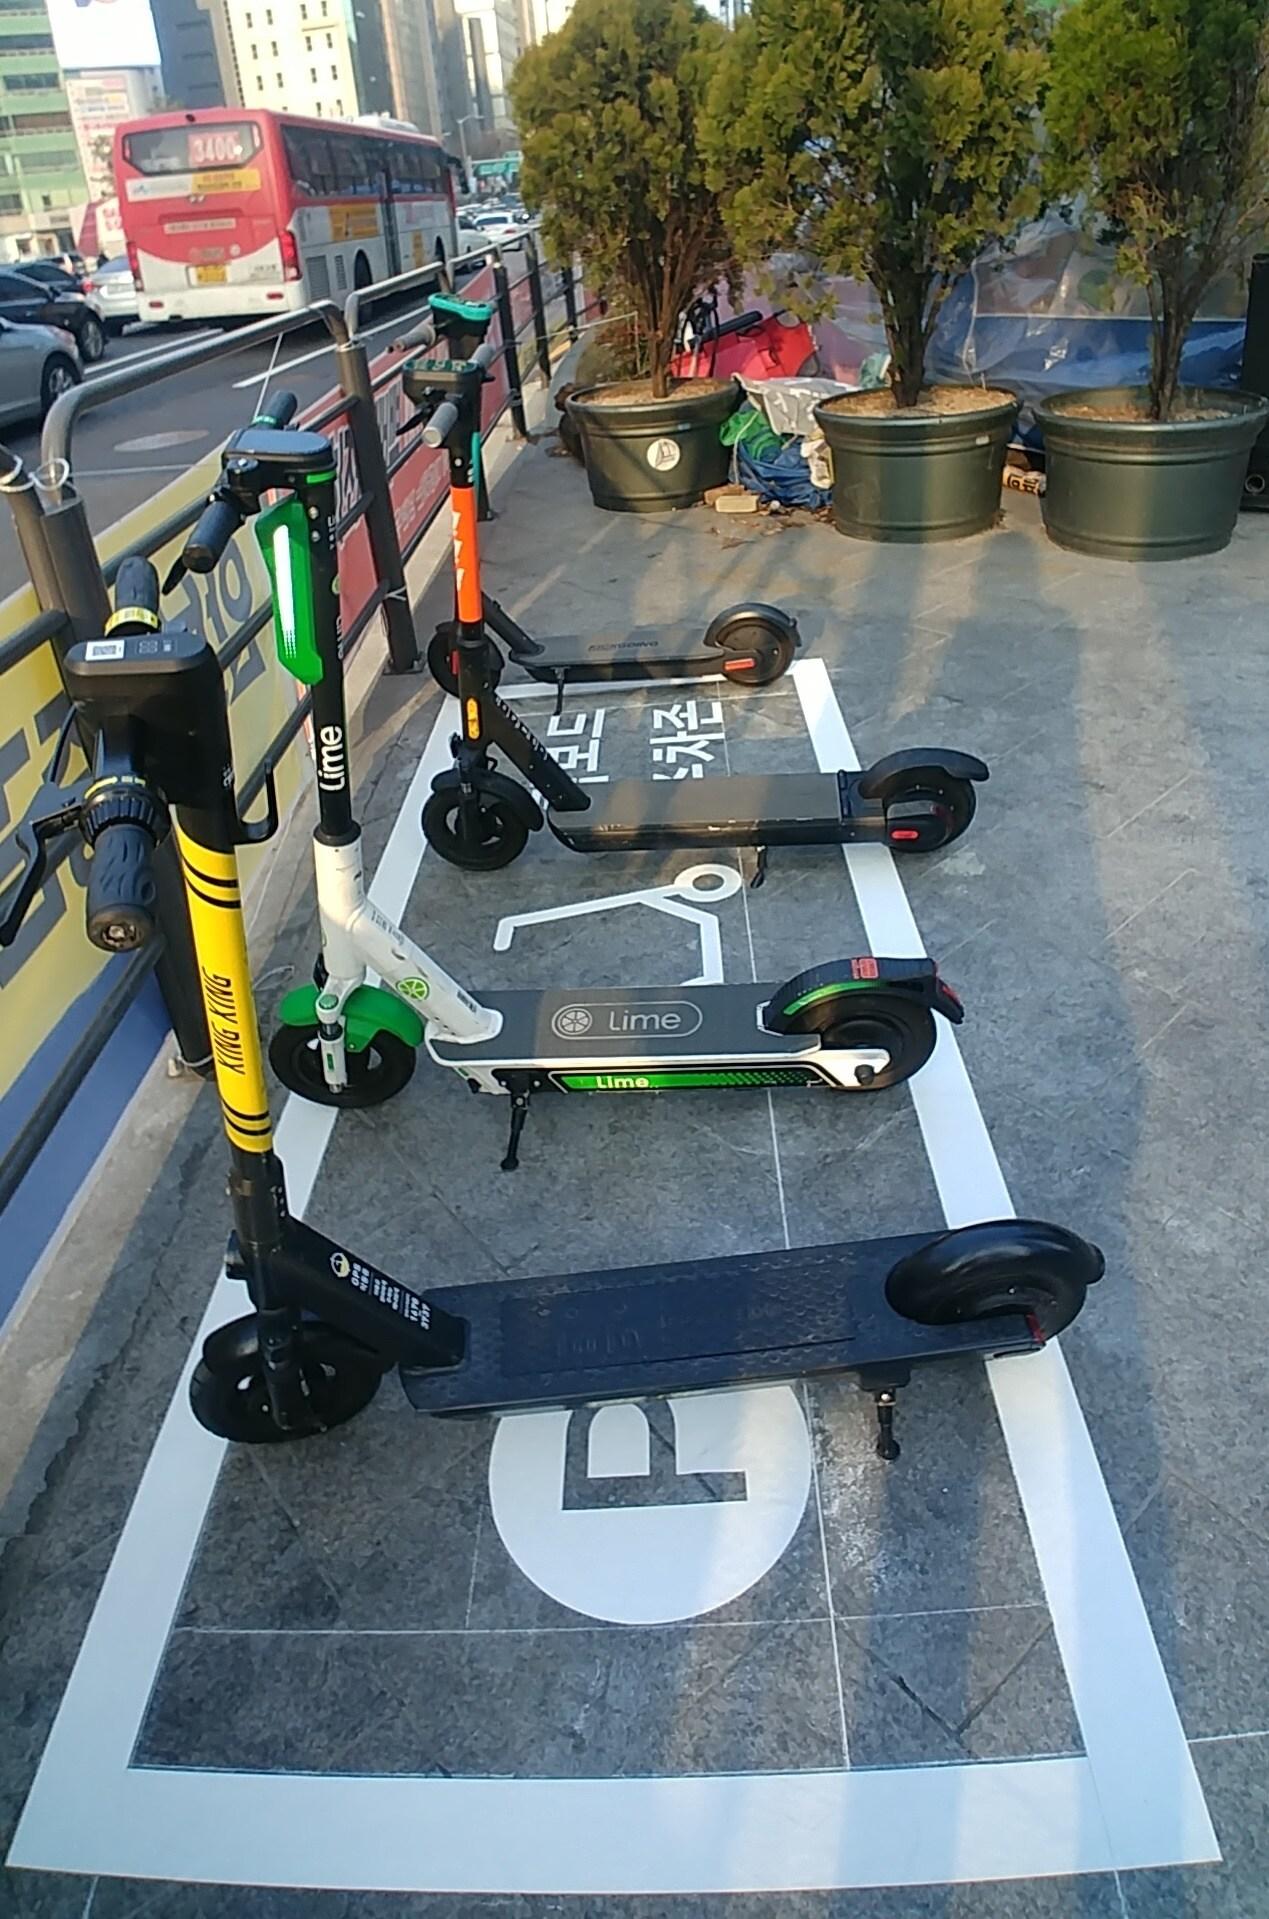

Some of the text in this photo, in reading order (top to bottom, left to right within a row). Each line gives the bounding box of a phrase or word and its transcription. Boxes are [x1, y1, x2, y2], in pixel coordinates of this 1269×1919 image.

[319, 725, 346, 792] Lime
[202, 966, 246, 1075] KING KING
[609, 1010, 681, 1031] Lime
[596, 1076, 649, 1089] Lime
[561, 1400, 748, 1511] P
